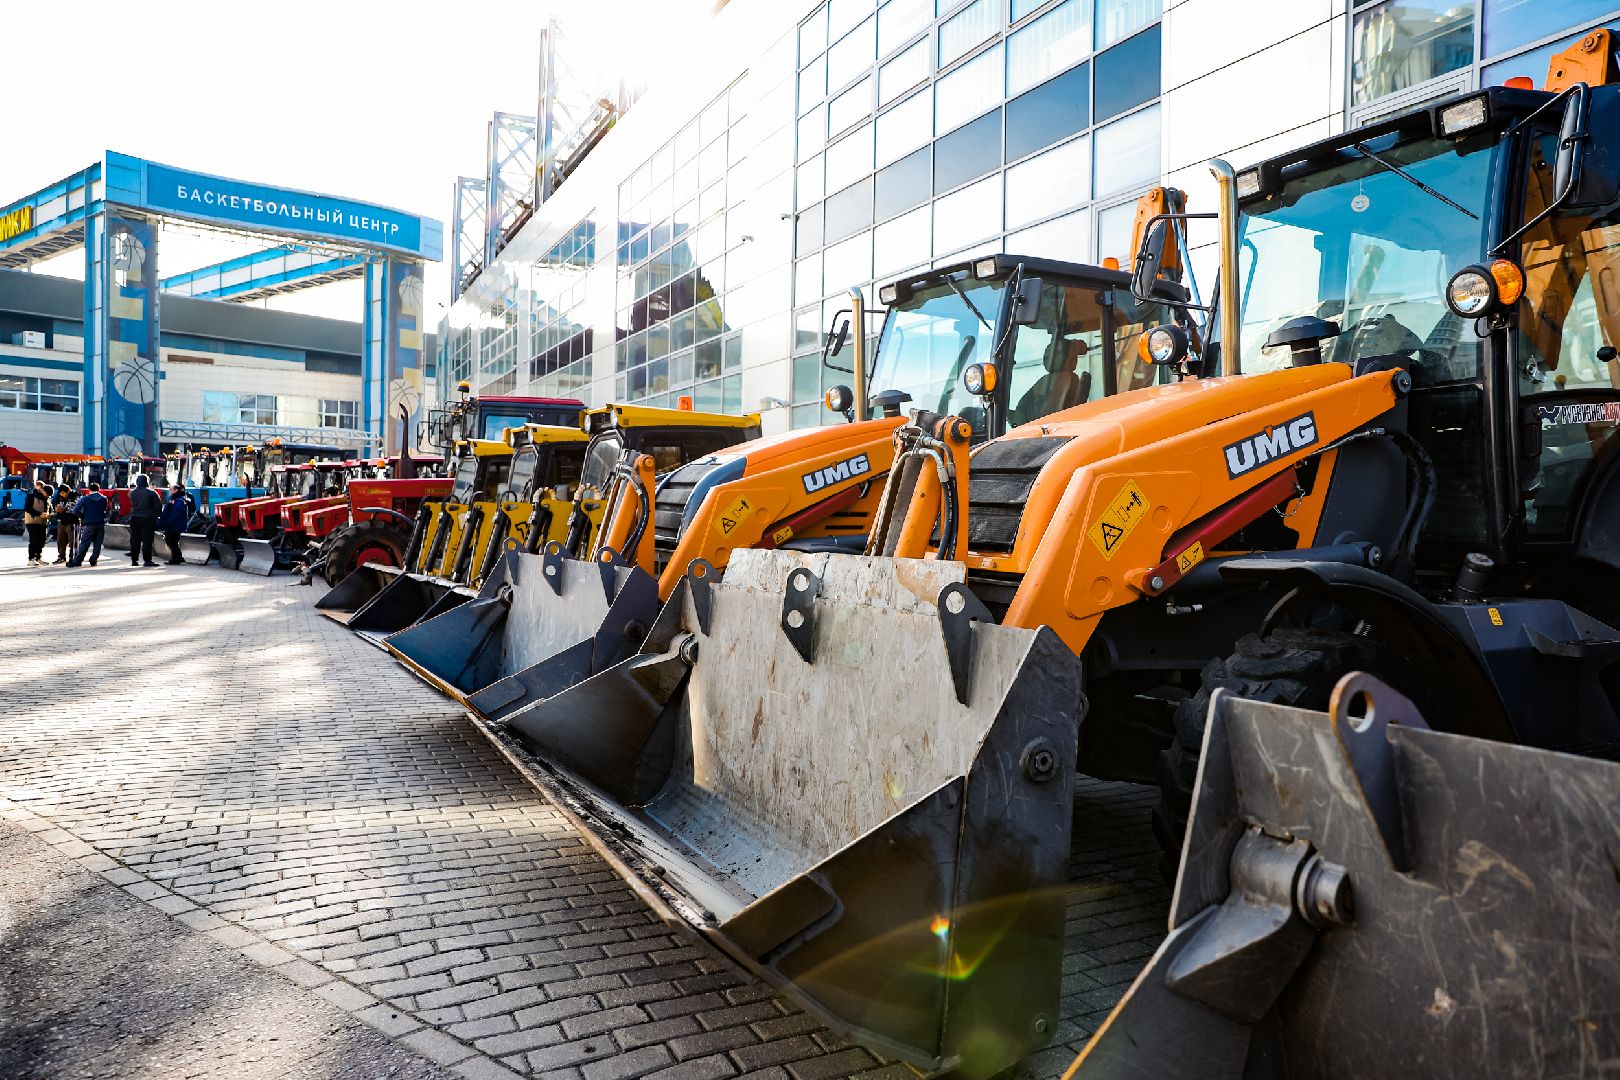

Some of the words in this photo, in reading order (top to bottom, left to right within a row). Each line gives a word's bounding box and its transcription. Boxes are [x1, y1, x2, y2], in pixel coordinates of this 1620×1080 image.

[0, 205, 31, 242] МКИ
[178, 185, 343, 224] БАСКЕТБОЛЬНЫЙ
[349, 215, 399, 235] ЦЕНТР
[1561, 402, 1620, 424] РУСБИЗНЕСАВТ
[1226, 416, 1315, 475] UMG
[804, 455, 869, 492] UMG
